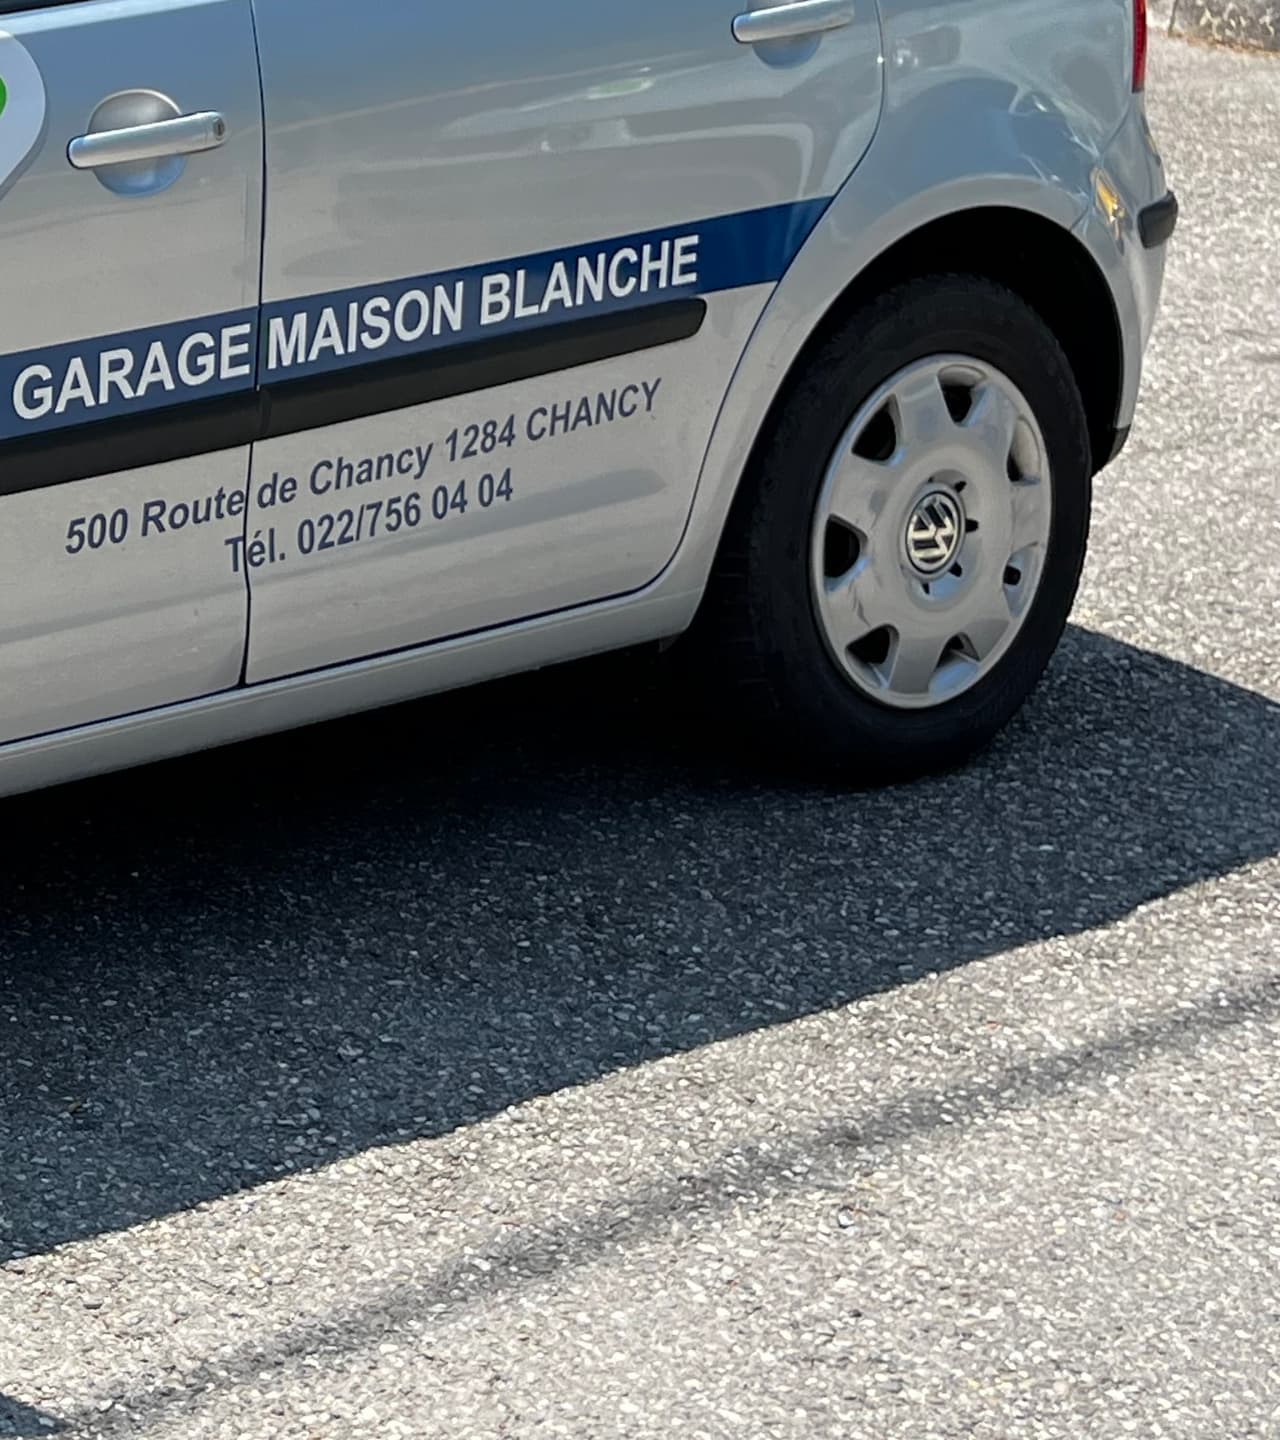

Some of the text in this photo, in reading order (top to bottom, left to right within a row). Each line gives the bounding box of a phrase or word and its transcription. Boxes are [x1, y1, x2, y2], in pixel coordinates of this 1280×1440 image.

[11, 235, 700, 420] GARAGE MAISON BLANCHE
[65, 378, 662, 555] 500 Route de Chancy 1284 CHANCY
[225, 467, 514, 573] Tél. 022/756 04 04
